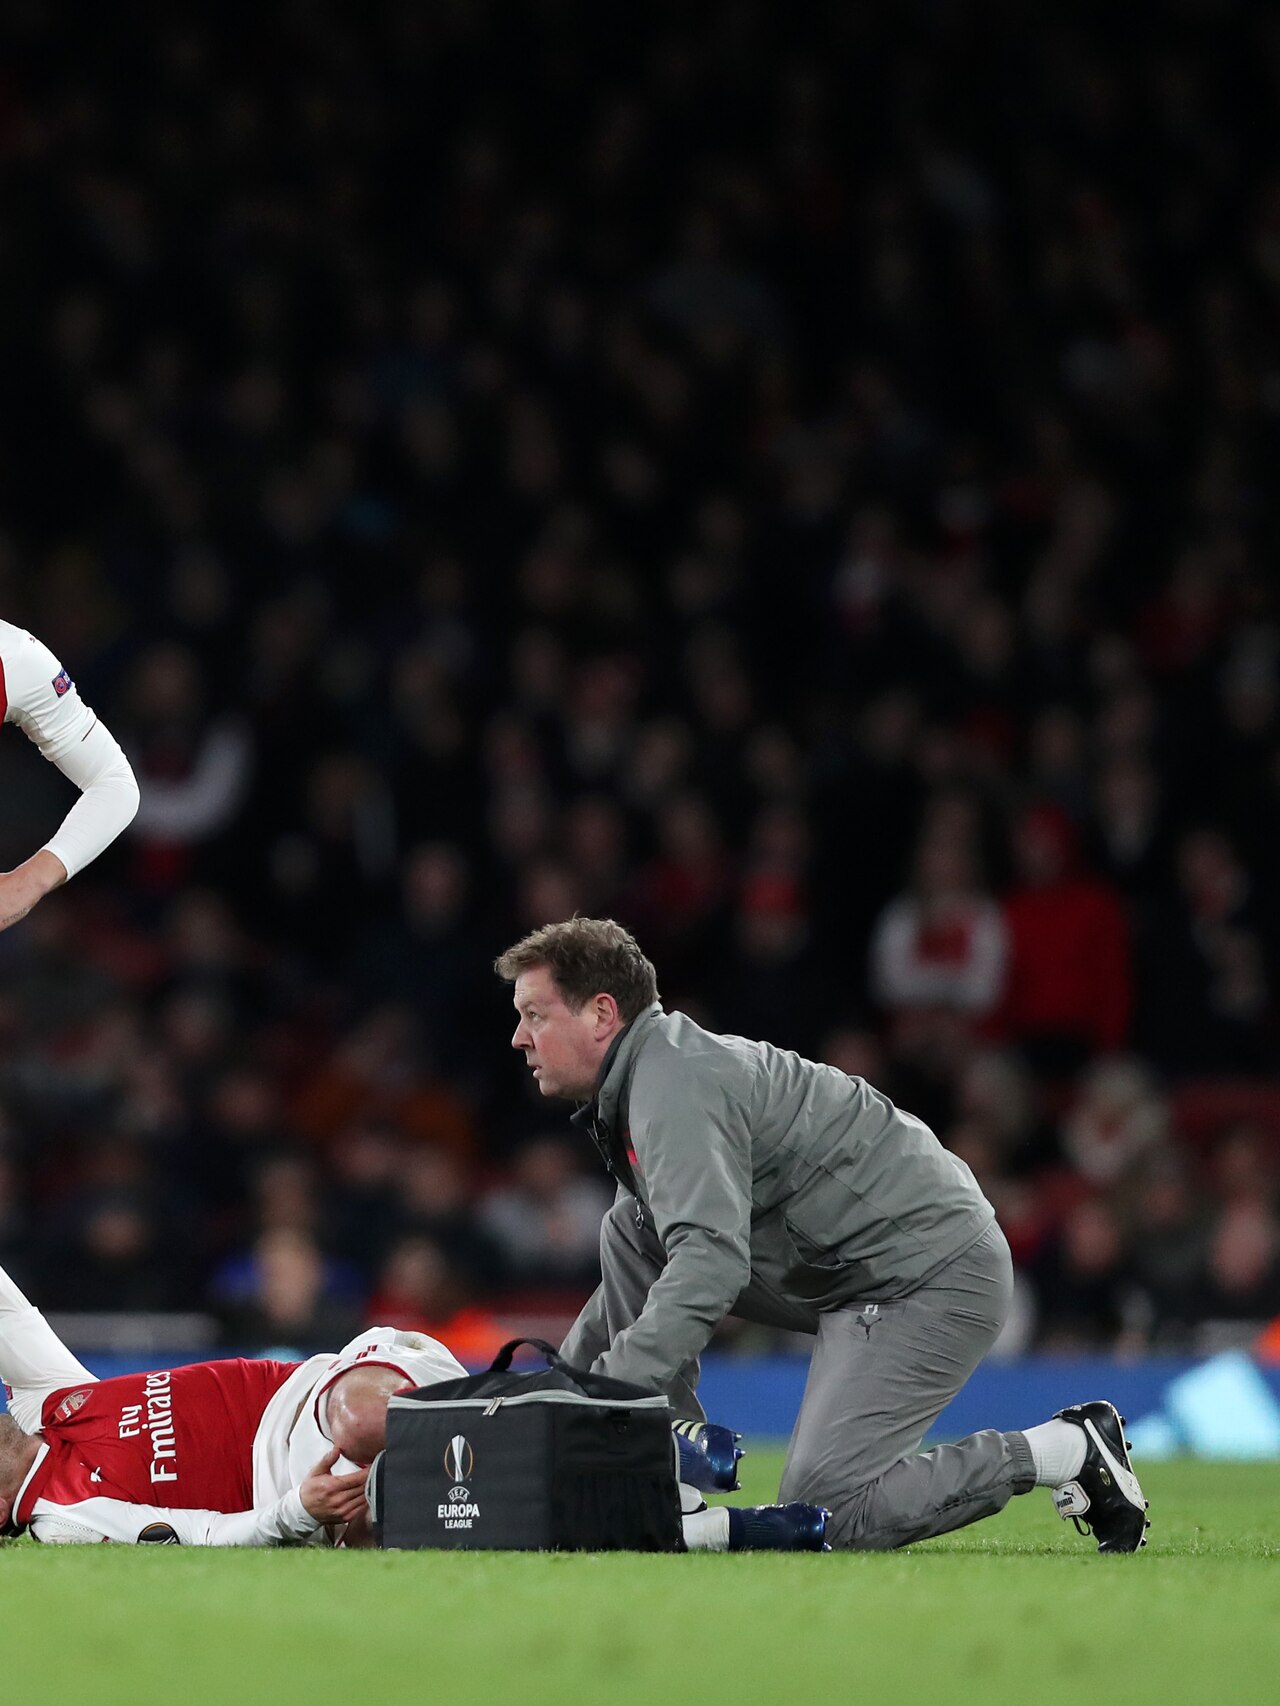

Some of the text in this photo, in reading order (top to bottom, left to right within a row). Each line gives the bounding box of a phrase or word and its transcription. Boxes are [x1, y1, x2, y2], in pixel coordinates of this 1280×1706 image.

[118, 1404, 143, 1439] Fly
[141, 1371, 178, 1484] Emirates
[448, 1488, 469, 1501] UEFA
[437, 1503, 480, 1518] EUROPA
[444, 1519, 473, 1529] LEAGUE
